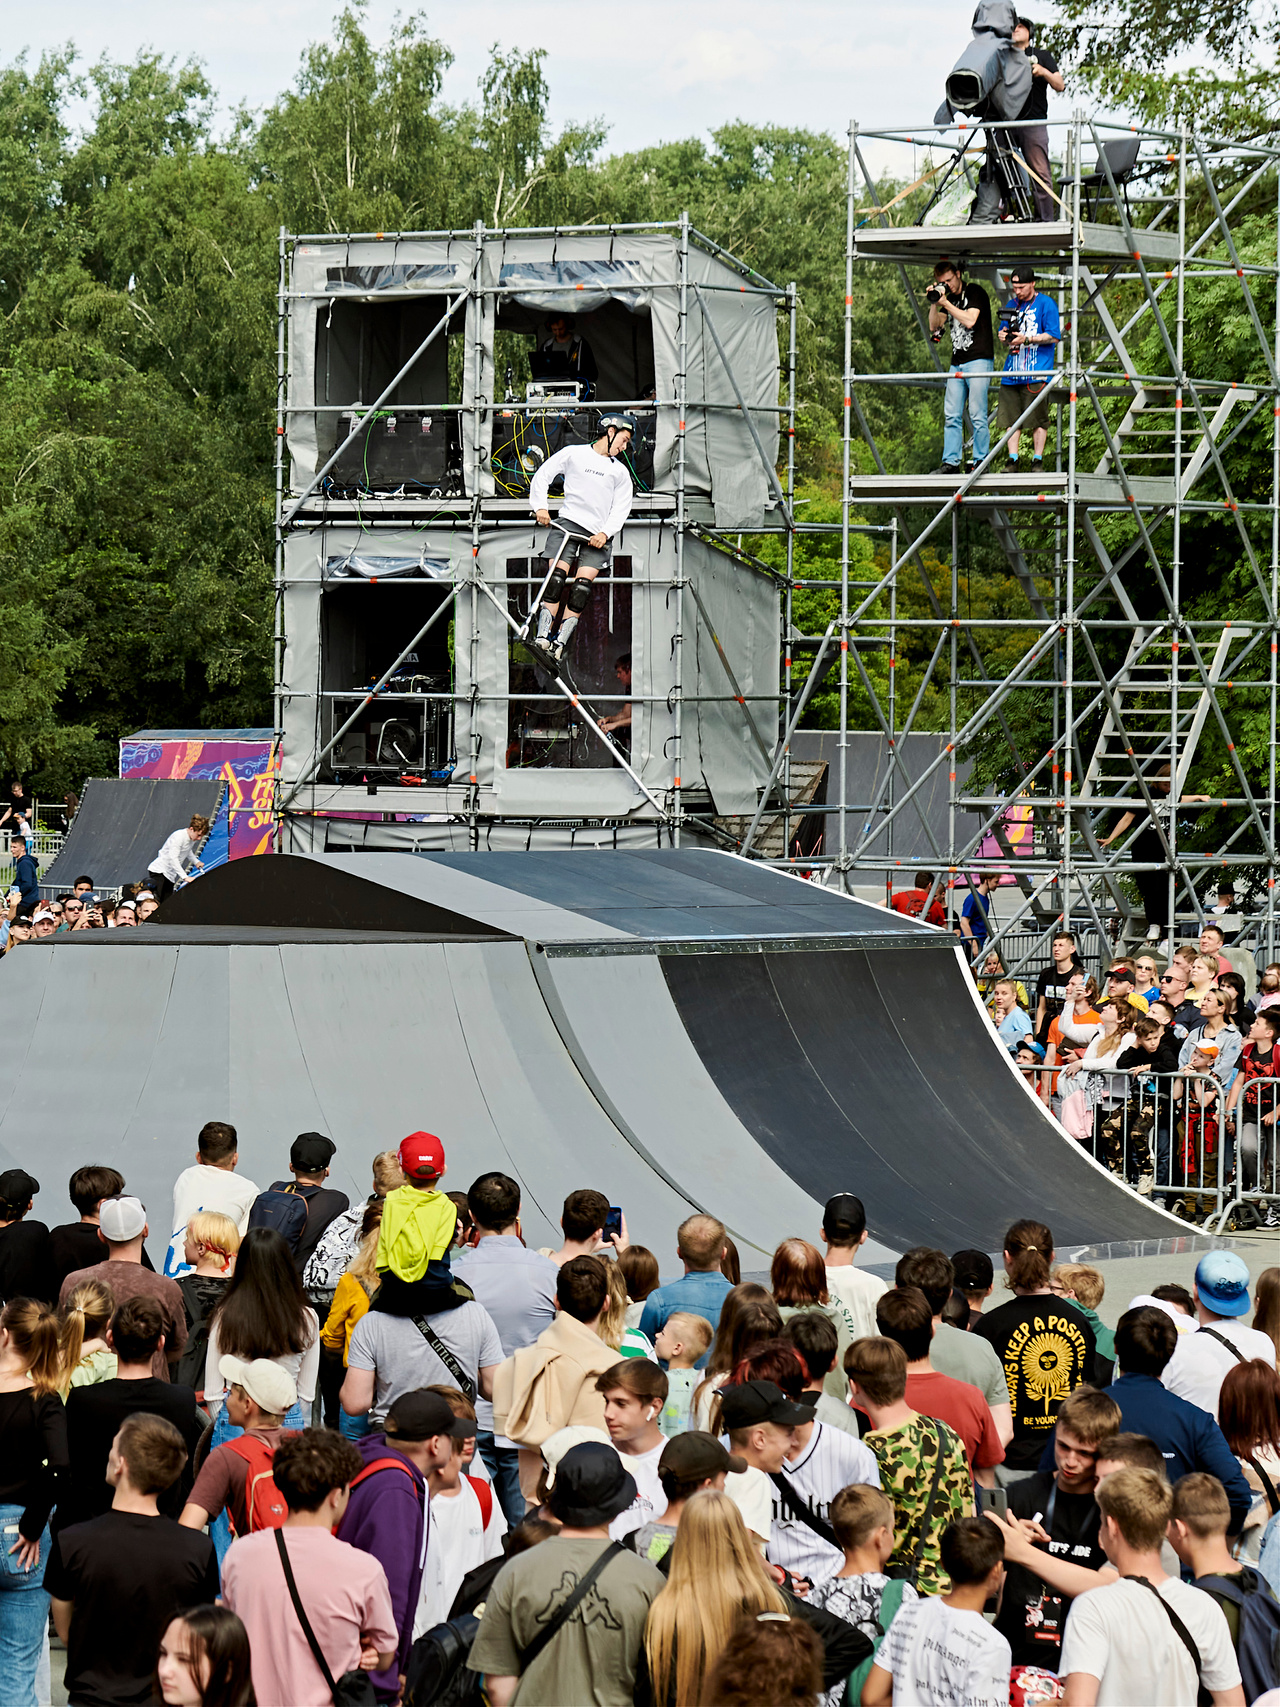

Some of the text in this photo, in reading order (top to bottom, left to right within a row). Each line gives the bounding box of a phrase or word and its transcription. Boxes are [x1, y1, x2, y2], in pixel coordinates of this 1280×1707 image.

[1004, 1322, 1031, 1361] KEEP
[1033, 1316, 1046, 1332] A
[431, 1339, 453, 1365] LITTLE
[1023, 1417, 1034, 1425] BE
[1049, 1541, 1070, 1554] ET'S
